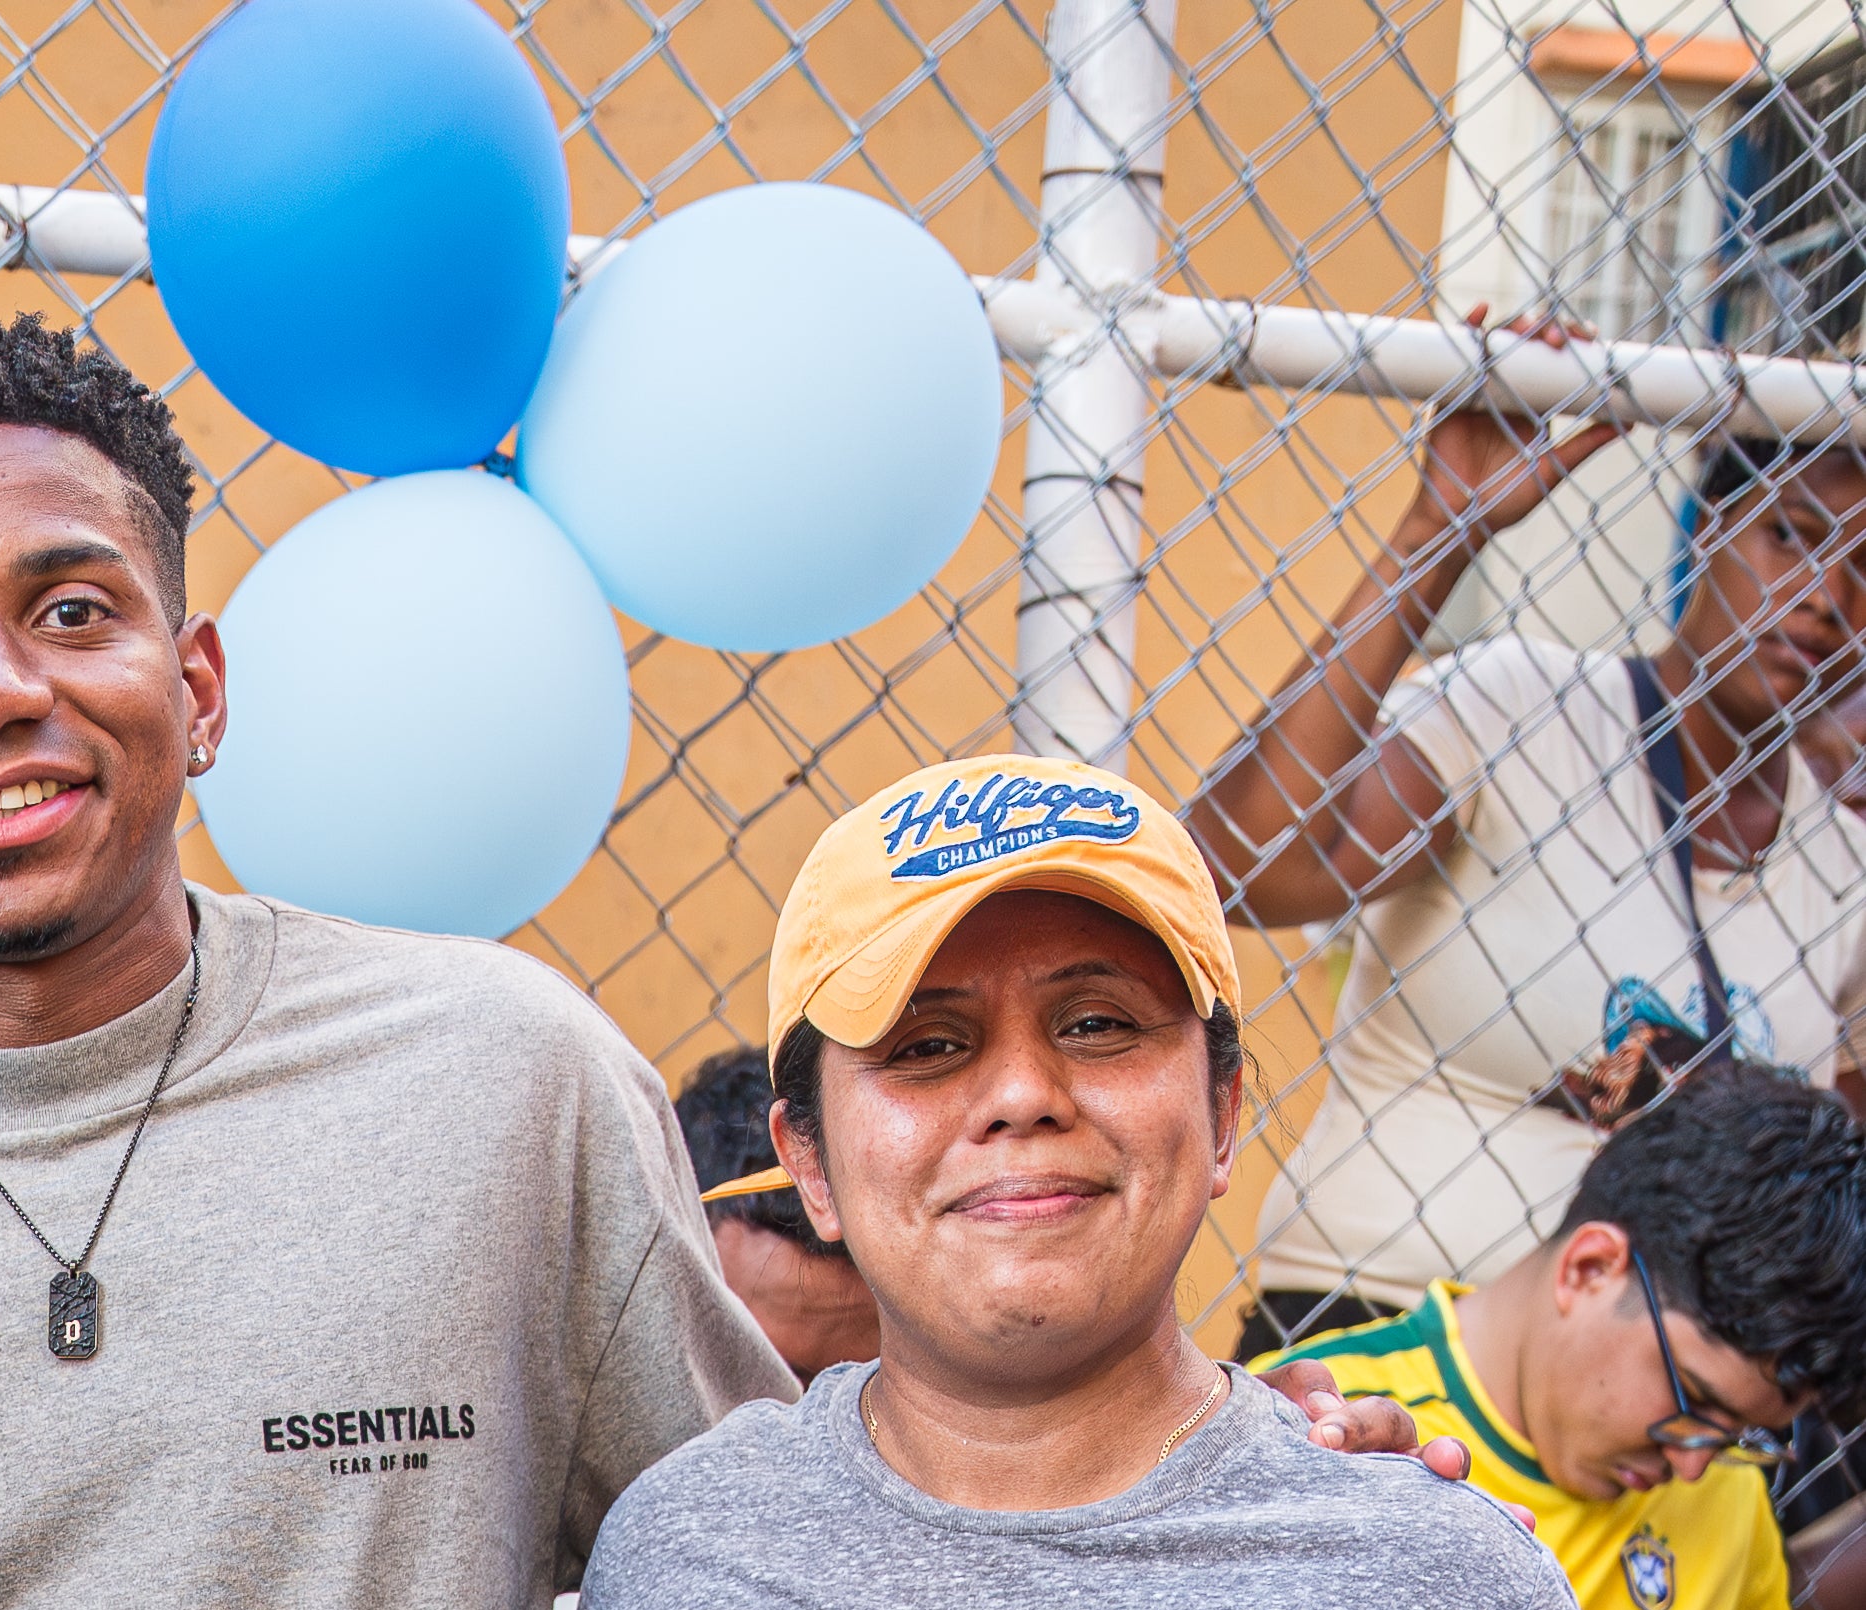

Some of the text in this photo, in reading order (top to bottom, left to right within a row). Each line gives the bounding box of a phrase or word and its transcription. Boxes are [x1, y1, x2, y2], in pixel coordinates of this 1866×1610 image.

[880, 773, 1139, 855] Hilfiger
[937, 825, 1058, 871] CHAMPIONS
[261, 1403, 476, 1453] ESSENTIALS
[329, 1452, 428, 1475] FEAR OF GOD
